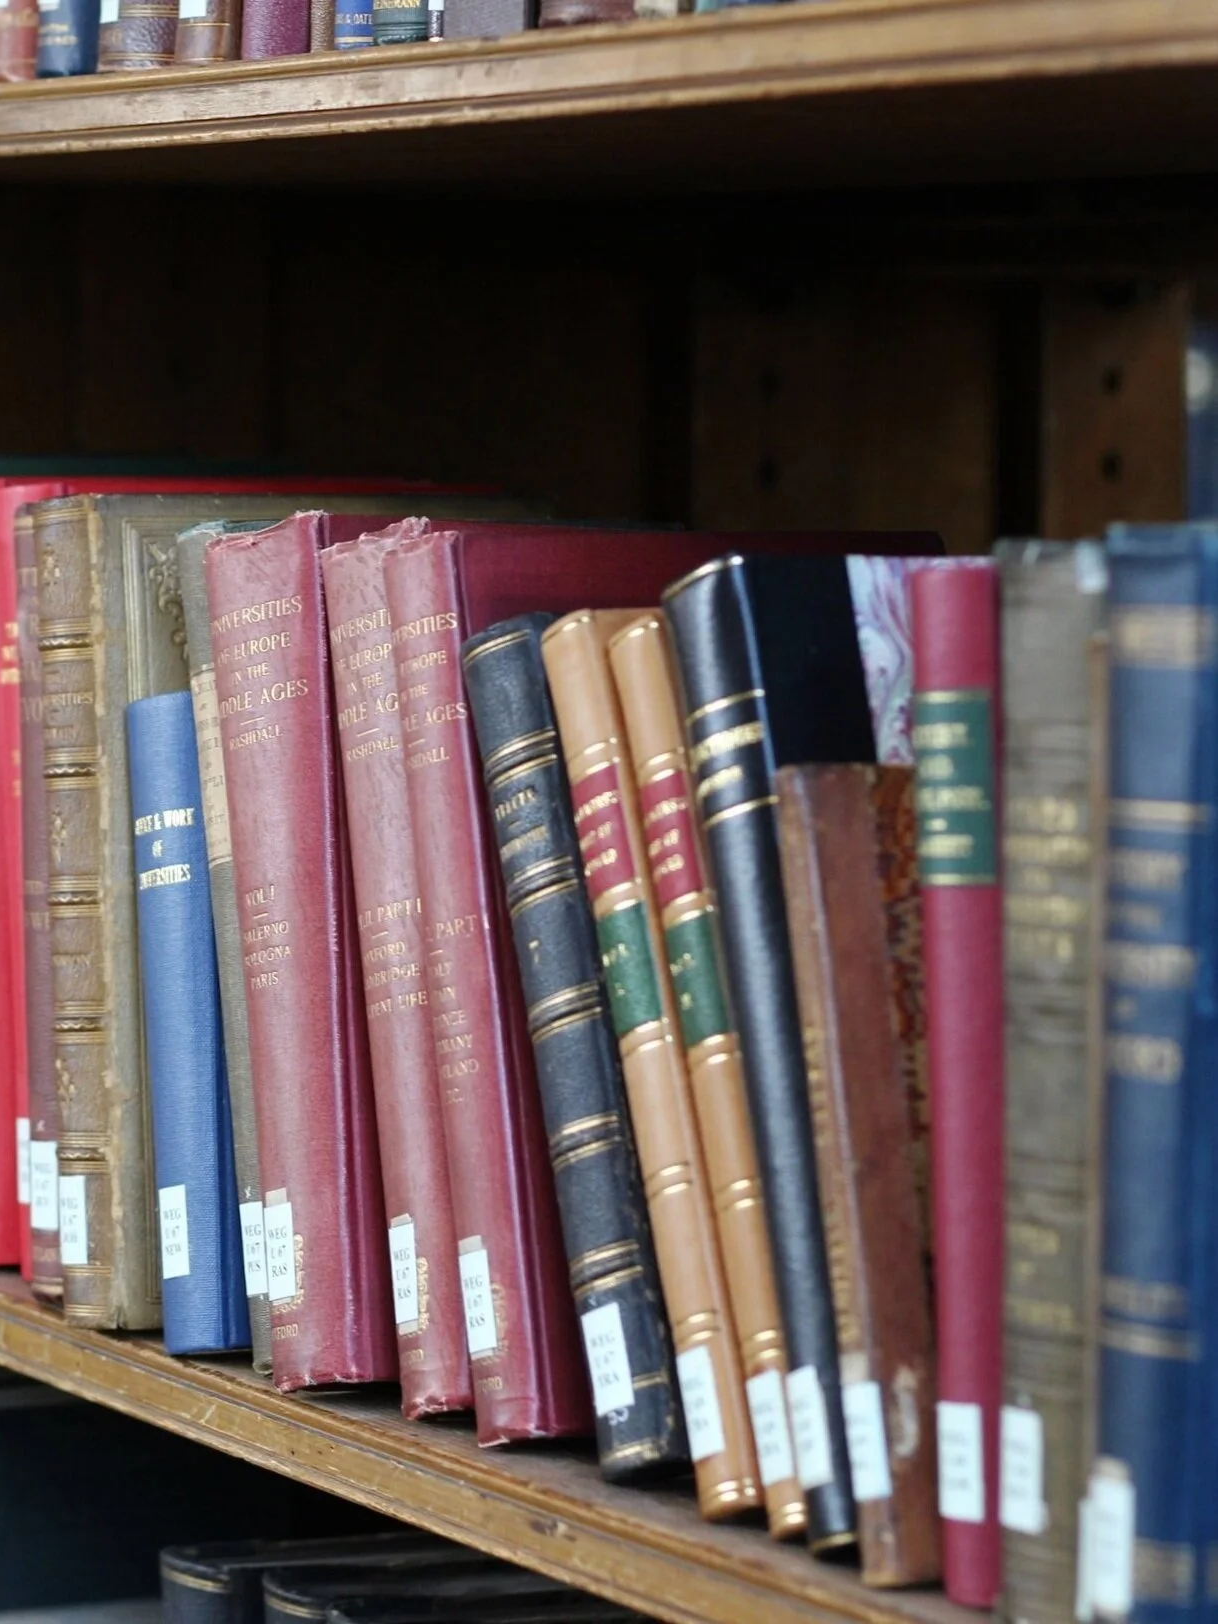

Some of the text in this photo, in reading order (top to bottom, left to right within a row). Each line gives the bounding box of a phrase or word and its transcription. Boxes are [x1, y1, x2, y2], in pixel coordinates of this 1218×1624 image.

[234, 632, 291, 660] EUROPE
[350, 643, 392, 670] EUROP
[246, 662, 270, 680] THE
[260, 678, 309, 705] AGES
[375, 692, 399, 715] AG
